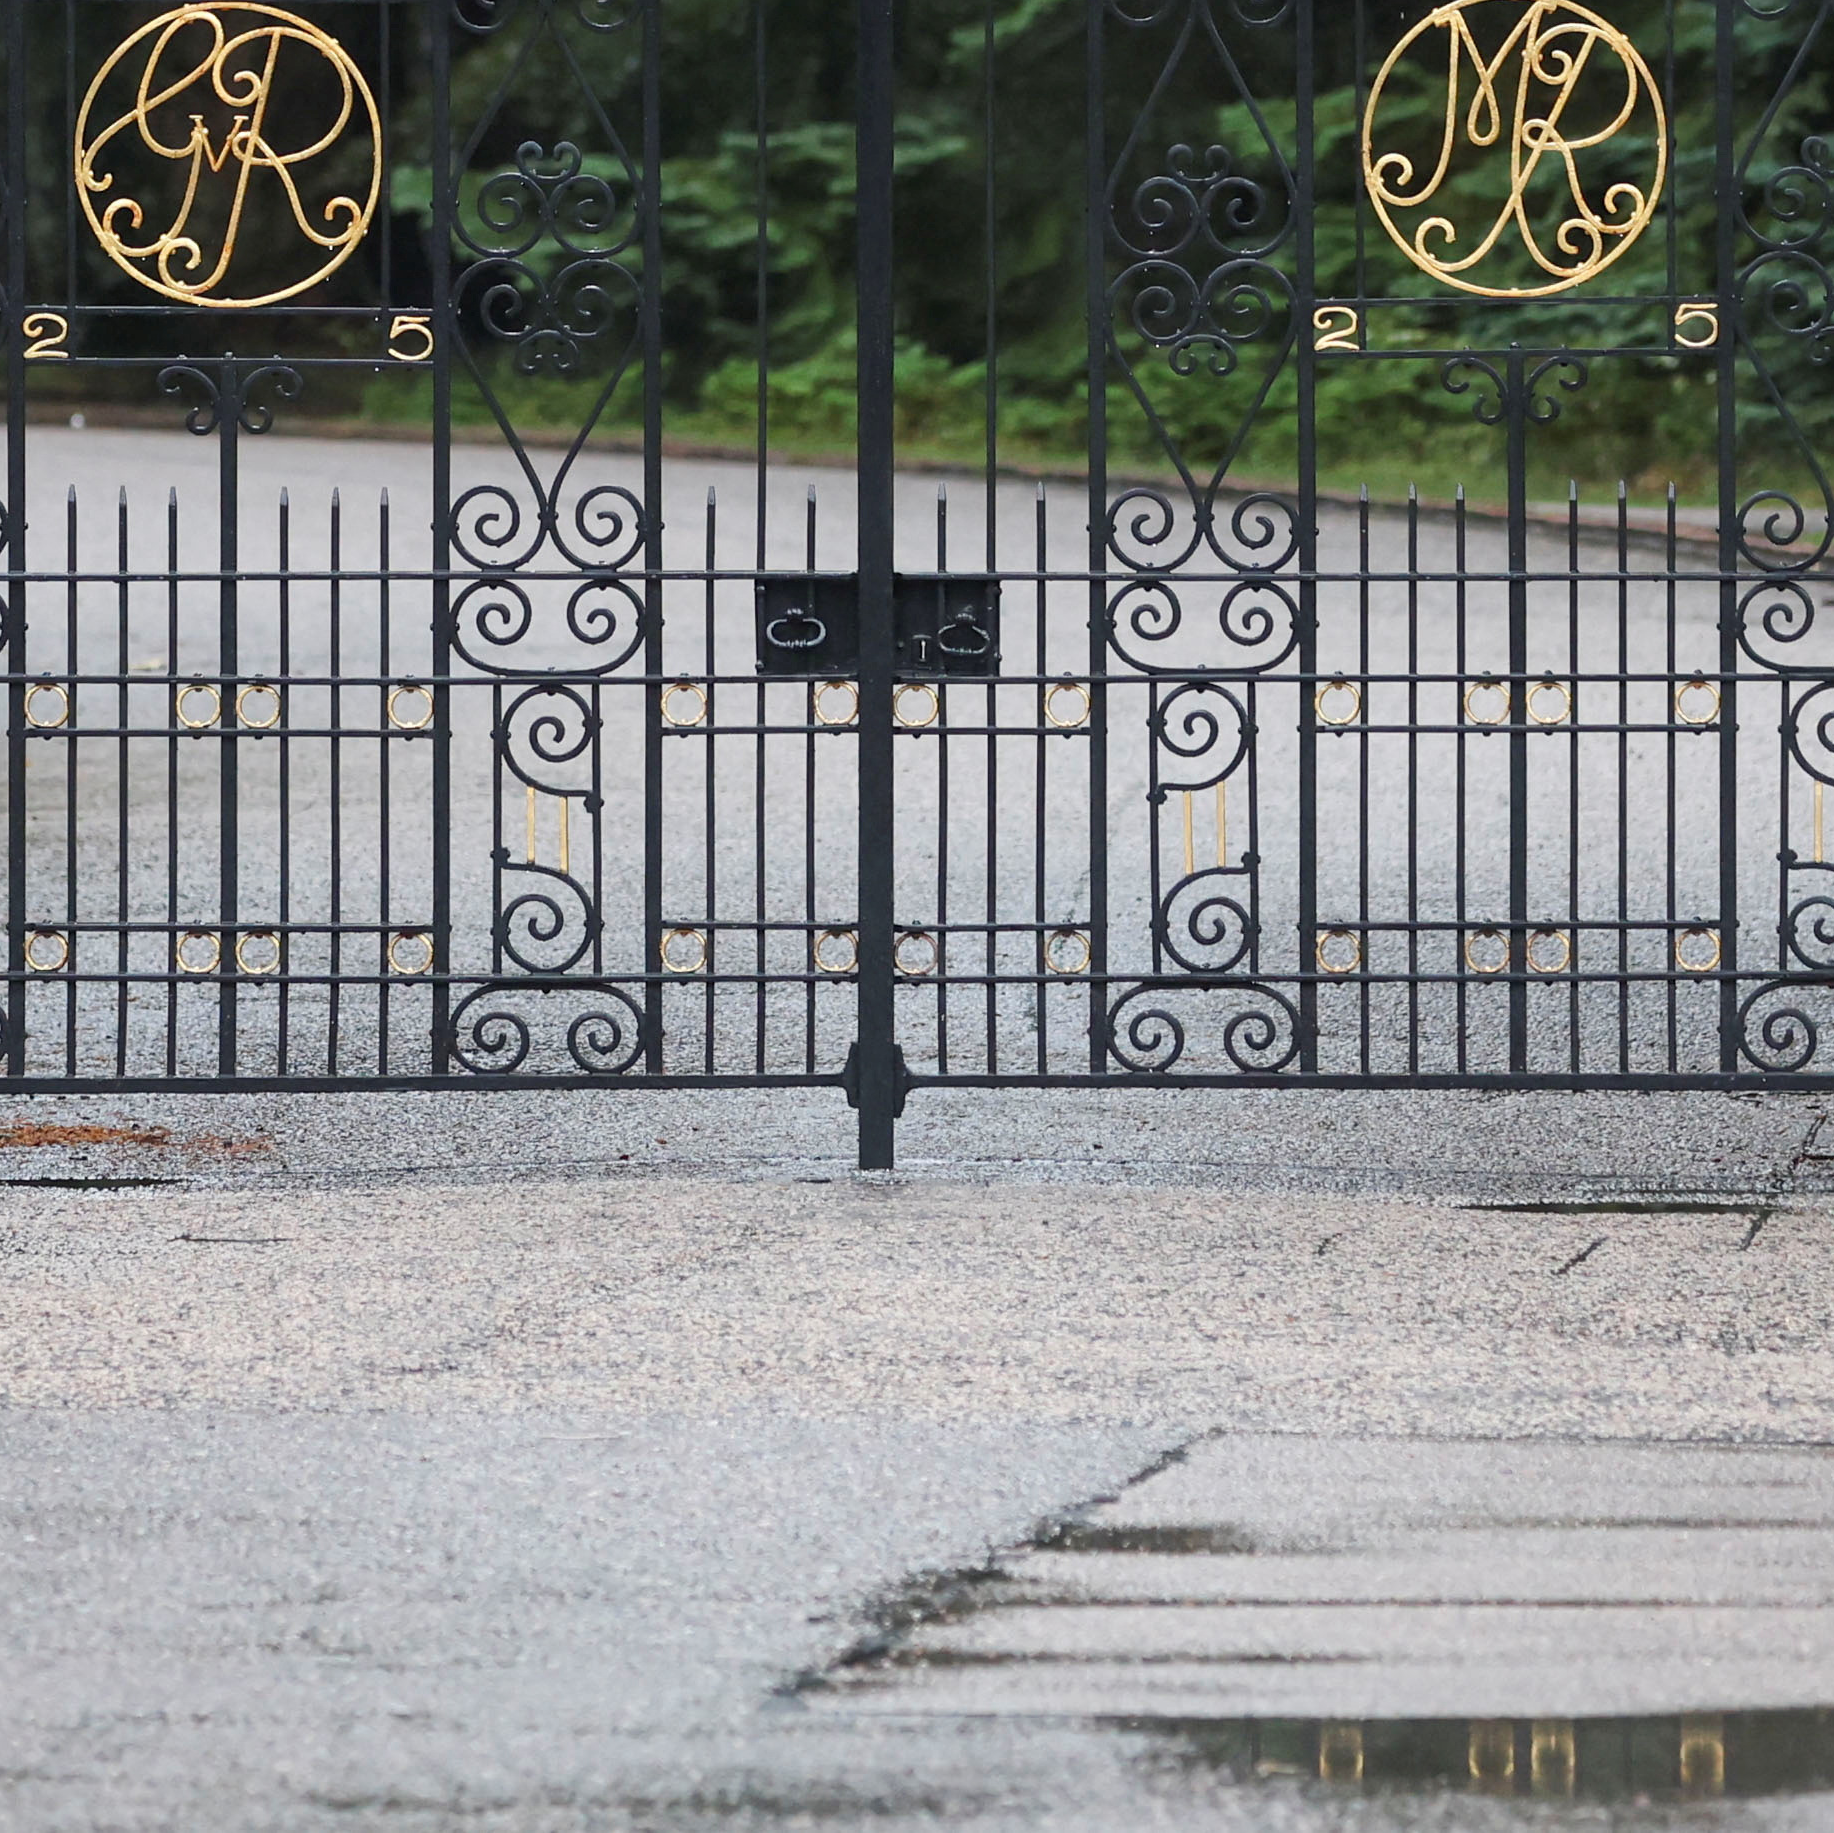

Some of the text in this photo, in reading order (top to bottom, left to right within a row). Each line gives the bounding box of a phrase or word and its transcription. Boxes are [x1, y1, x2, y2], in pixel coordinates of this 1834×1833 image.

[22, 312, 434, 362] 2 5
[1312, 302, 1720, 352] 2 5
